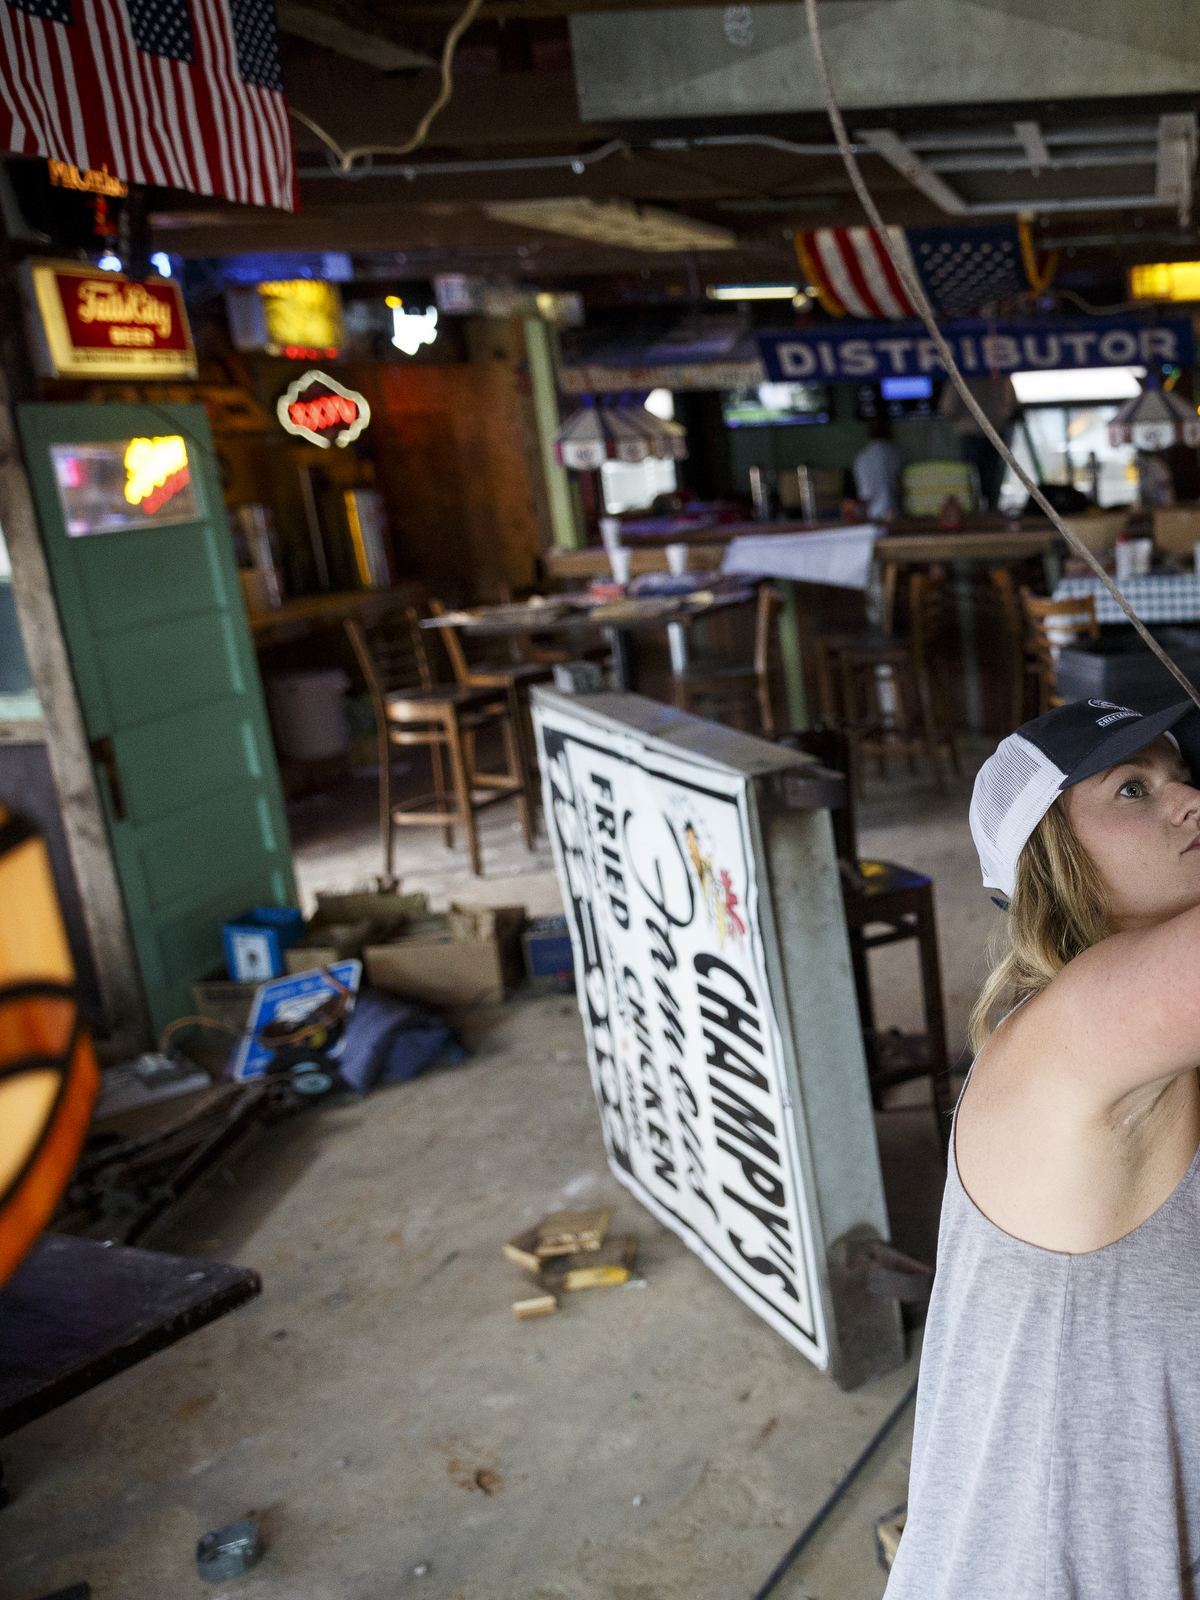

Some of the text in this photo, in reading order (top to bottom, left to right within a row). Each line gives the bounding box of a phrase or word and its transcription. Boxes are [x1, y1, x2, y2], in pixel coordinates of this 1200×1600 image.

[776, 328, 1178, 376] DISTRIBUTOR
[589, 772, 631, 931] FRIED
[623, 965, 679, 1192] CHICKEN
[622, 808, 720, 1224] Famous
[694, 952, 800, 1302] CHAMPY'S
